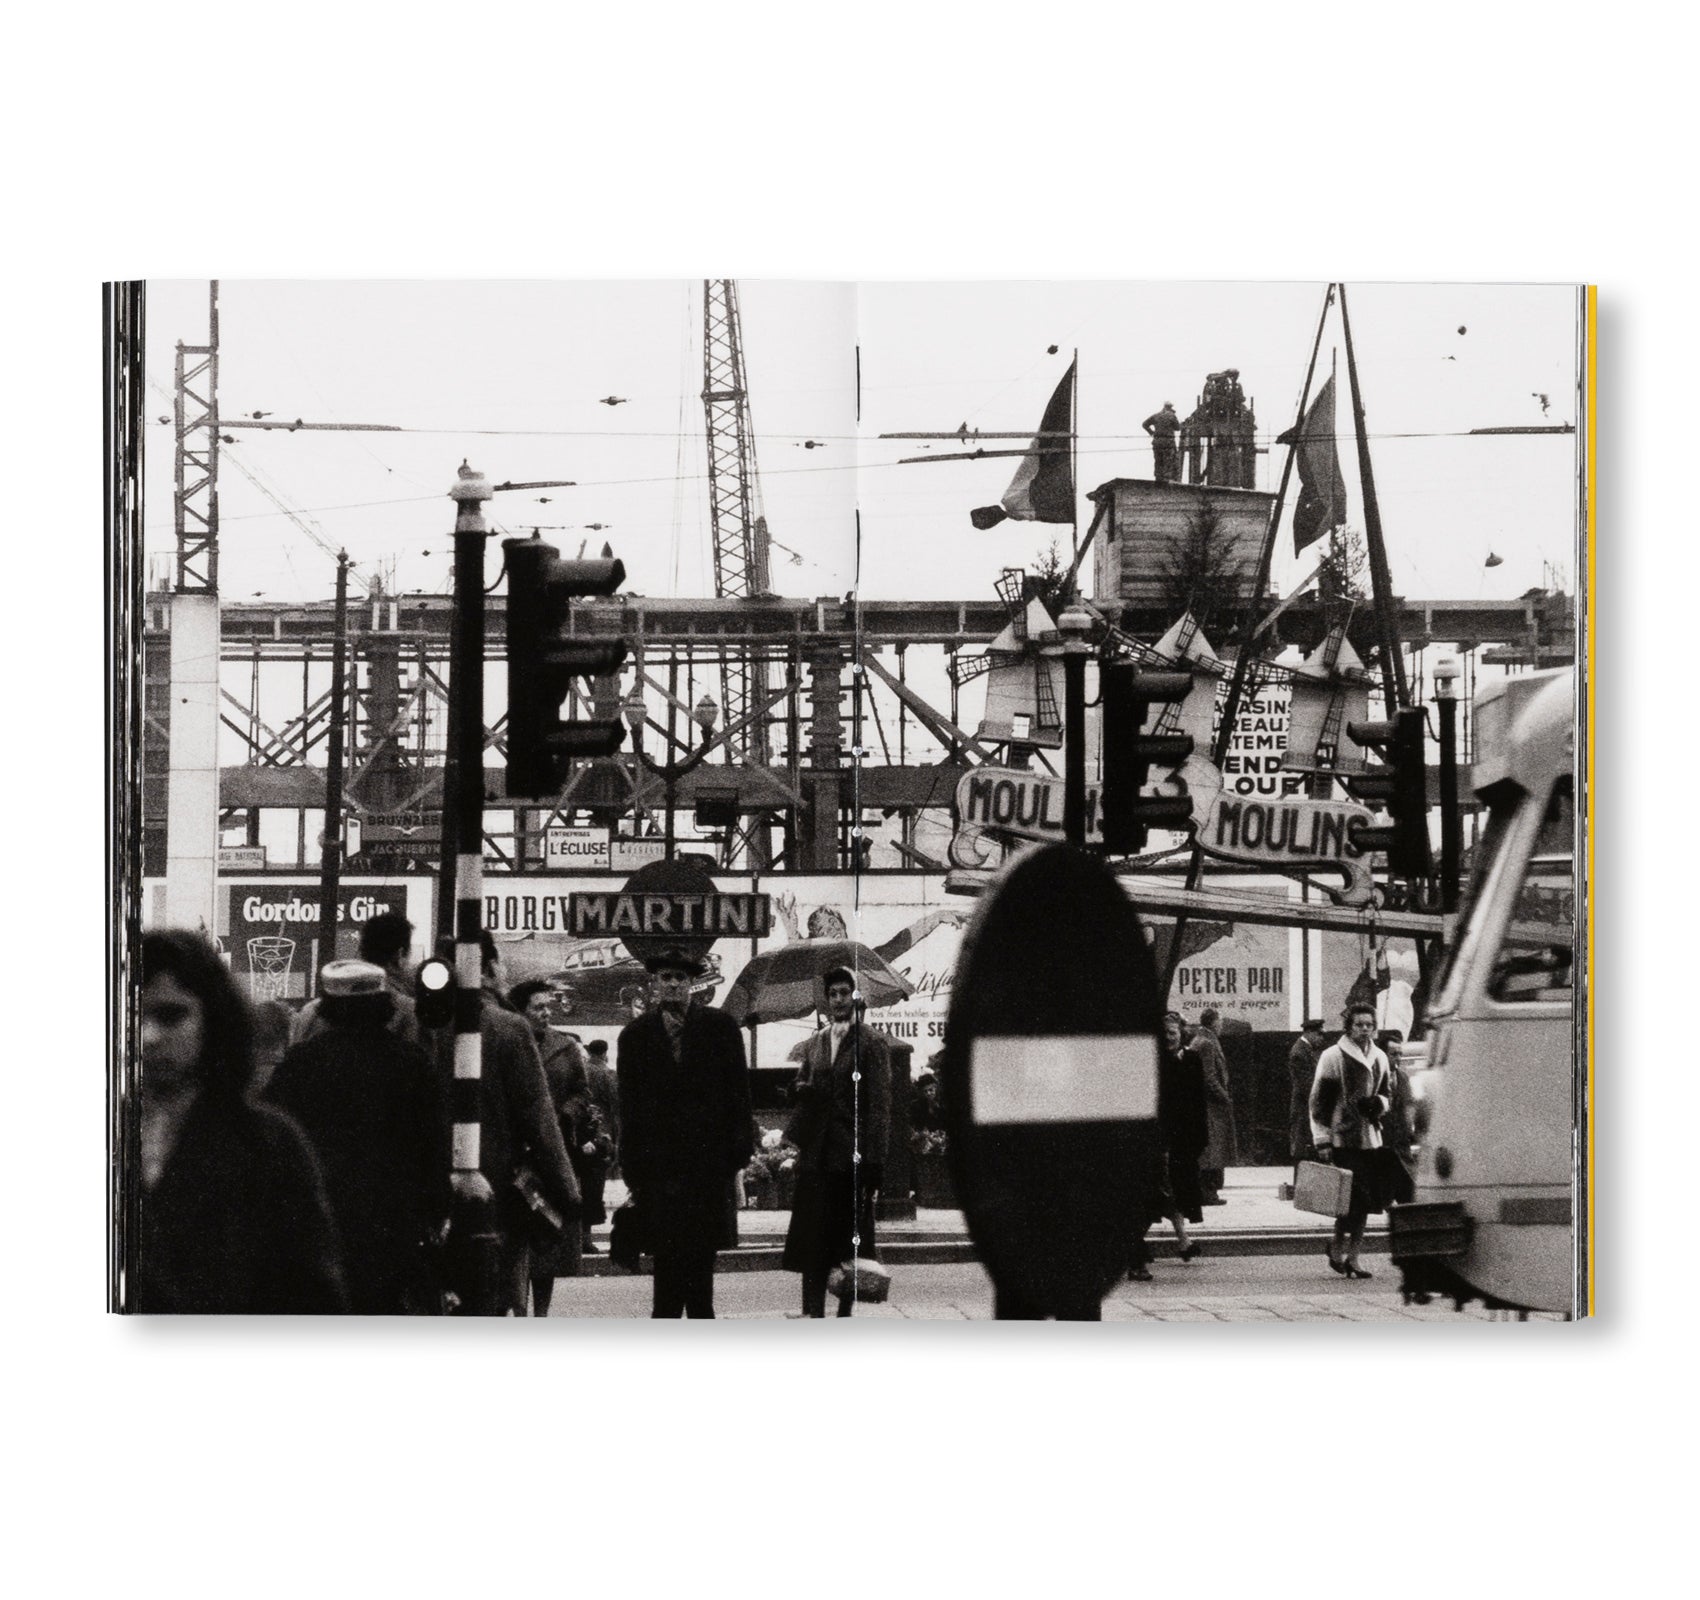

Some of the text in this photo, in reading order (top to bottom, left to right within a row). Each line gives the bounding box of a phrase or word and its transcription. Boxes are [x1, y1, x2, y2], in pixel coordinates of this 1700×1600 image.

[1216, 801, 1369, 859] MOULINS
[550, 839, 608, 856] L'ÉCLUSE
[575, 893, 766, 934] MARTINI
[1179, 967, 1283, 995] PETER PAN
[1182, 1000, 1223, 1010] gaines
[1240, 1000, 1280, 1010] gorges
[871, 1021, 918, 1037] TEXTILE
